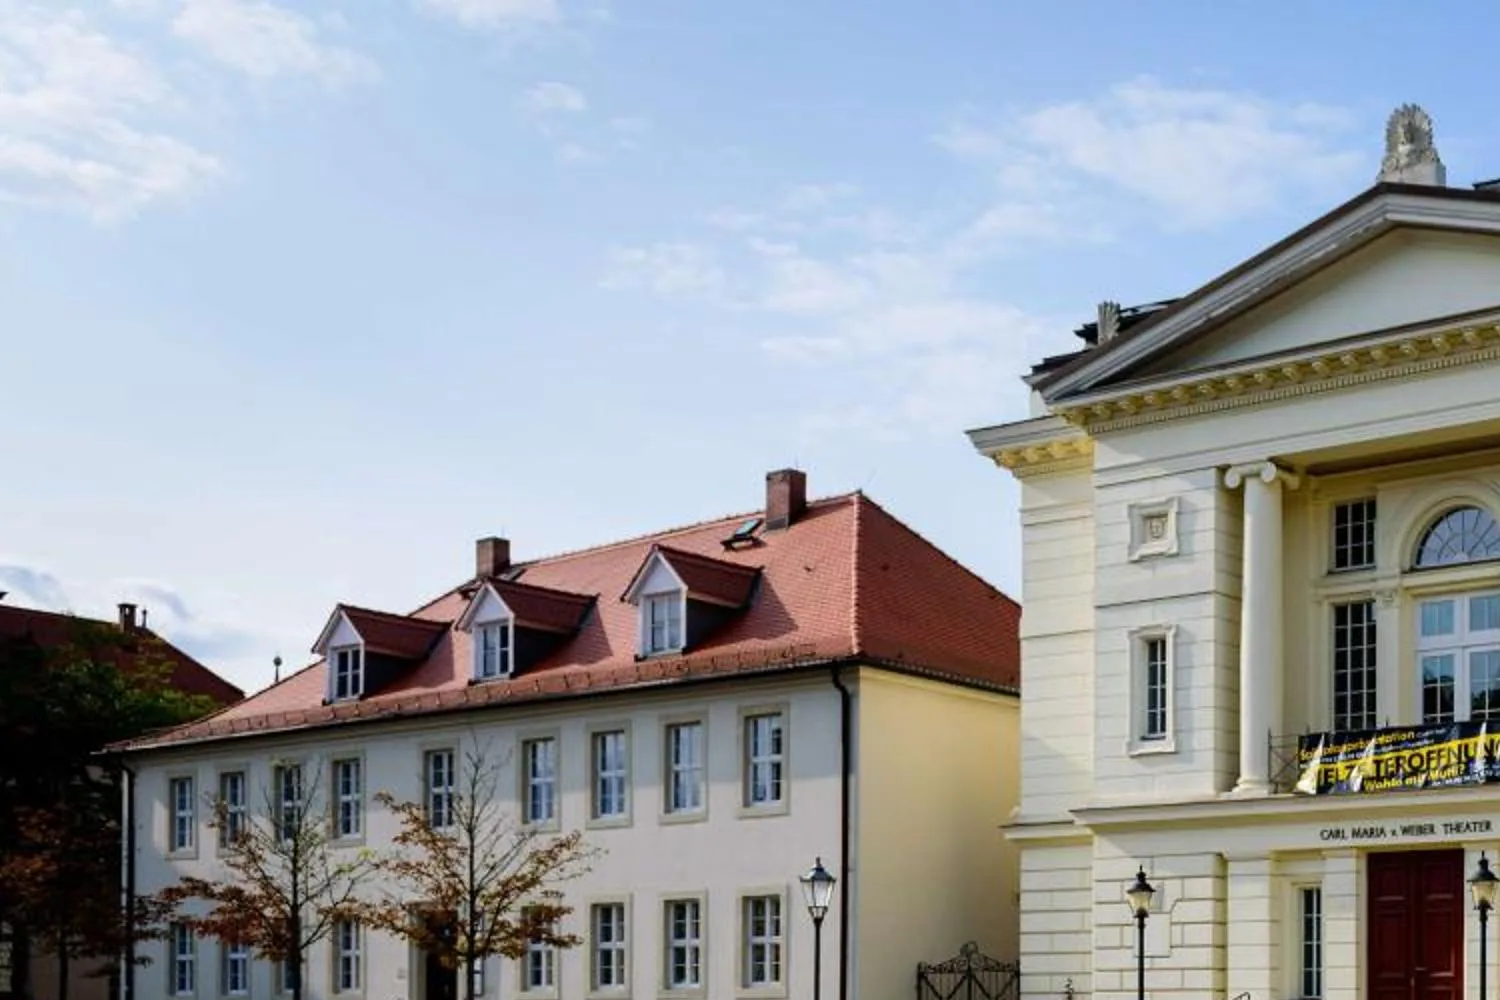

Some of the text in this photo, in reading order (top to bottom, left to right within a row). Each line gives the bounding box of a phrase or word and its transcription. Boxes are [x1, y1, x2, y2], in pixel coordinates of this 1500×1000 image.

[1320, 829, 1348, 841] CARL
[1352, 826, 1386, 839] MARIA
[1401, 823, 1435, 836] WEBER
[1442, 820, 1492, 835] THEATER
